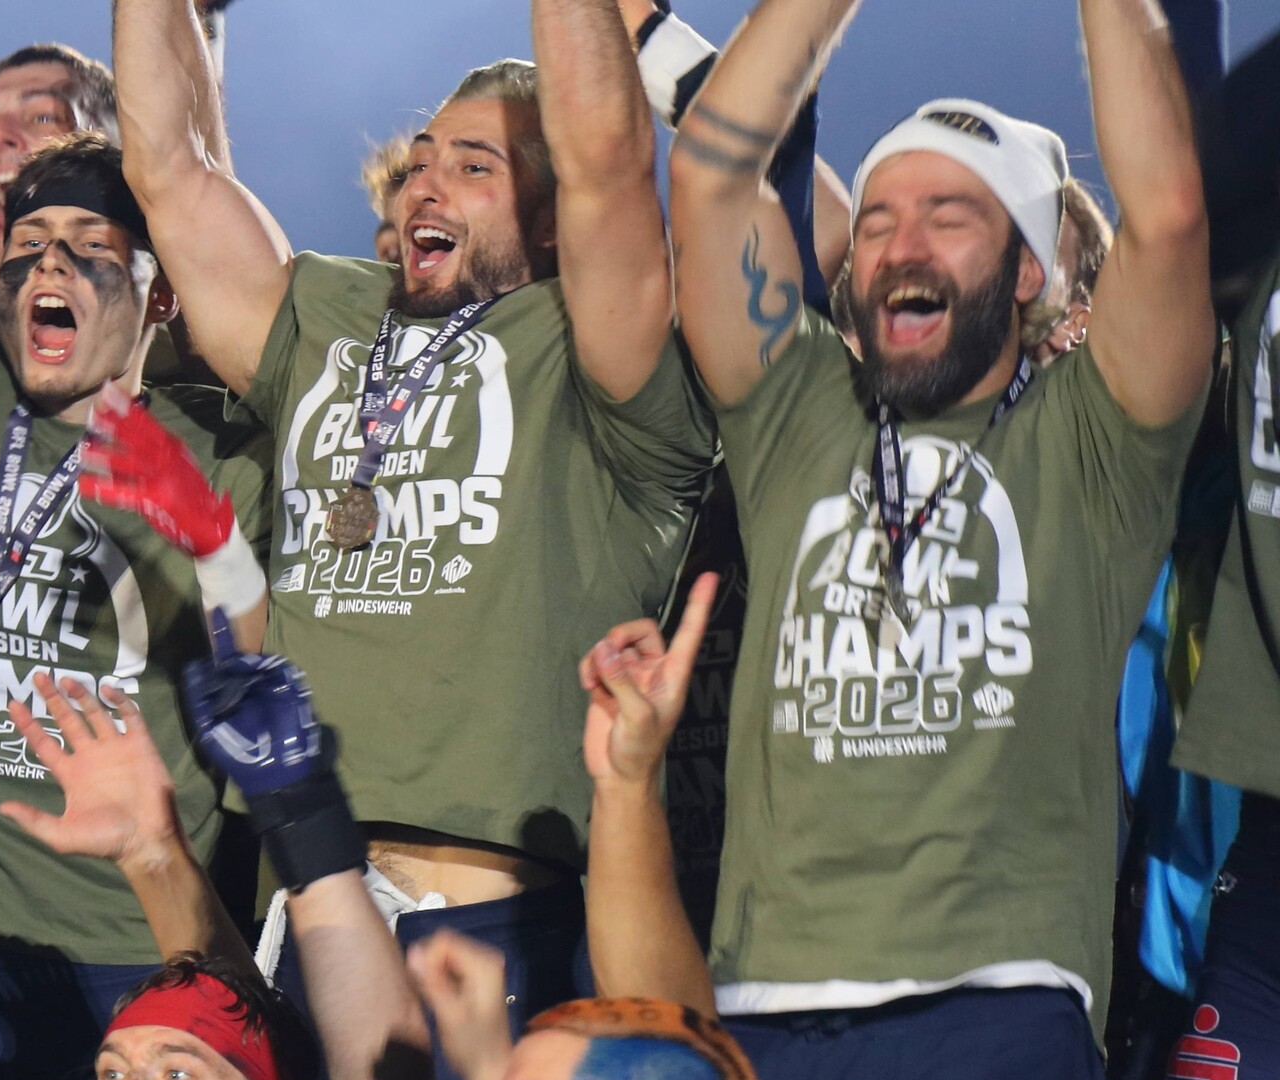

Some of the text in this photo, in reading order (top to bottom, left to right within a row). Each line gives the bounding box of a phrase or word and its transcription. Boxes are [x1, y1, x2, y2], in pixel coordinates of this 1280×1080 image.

[371, 344, 386, 382] 2026
[409, 355, 433, 380] GFL
[428, 319, 464, 352] BOWL
[0, 453, 23, 493] BOWL
[20, 510, 44, 535] GFL
[38, 472, 70, 510] BOWL
[307, 535, 438, 596] 2026
[337, 598, 413, 616] BUNDESWEHR
[774, 603, 1033, 690] CHAMPS
[803, 669, 965, 737] 2026
[842, 734, 949, 759] BUNDESWEHR
